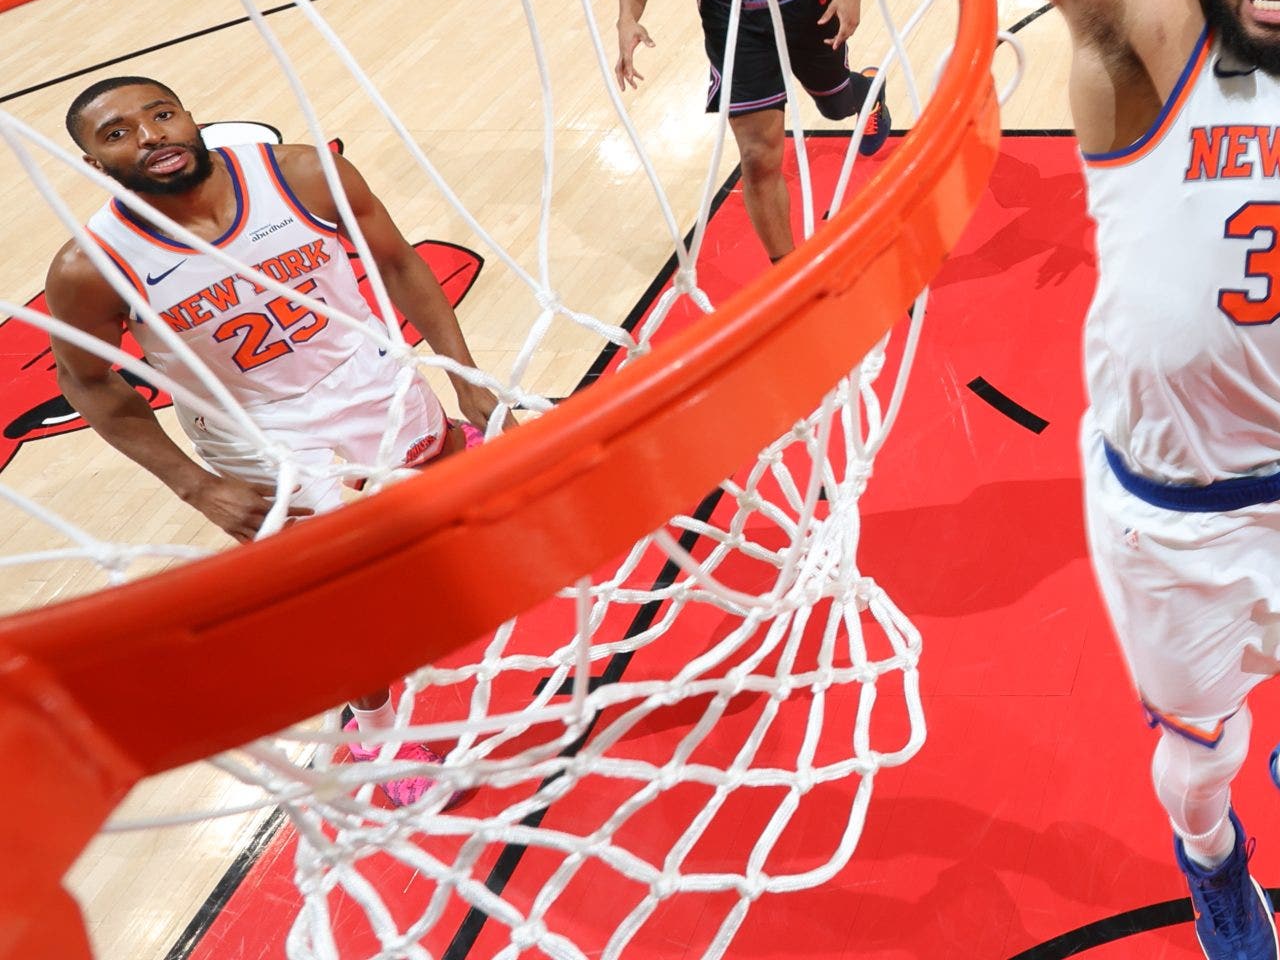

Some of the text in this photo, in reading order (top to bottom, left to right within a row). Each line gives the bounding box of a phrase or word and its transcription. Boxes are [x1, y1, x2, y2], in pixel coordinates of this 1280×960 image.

[159, 238, 331, 333] NEW YORK
[212, 277, 331, 373] 25
